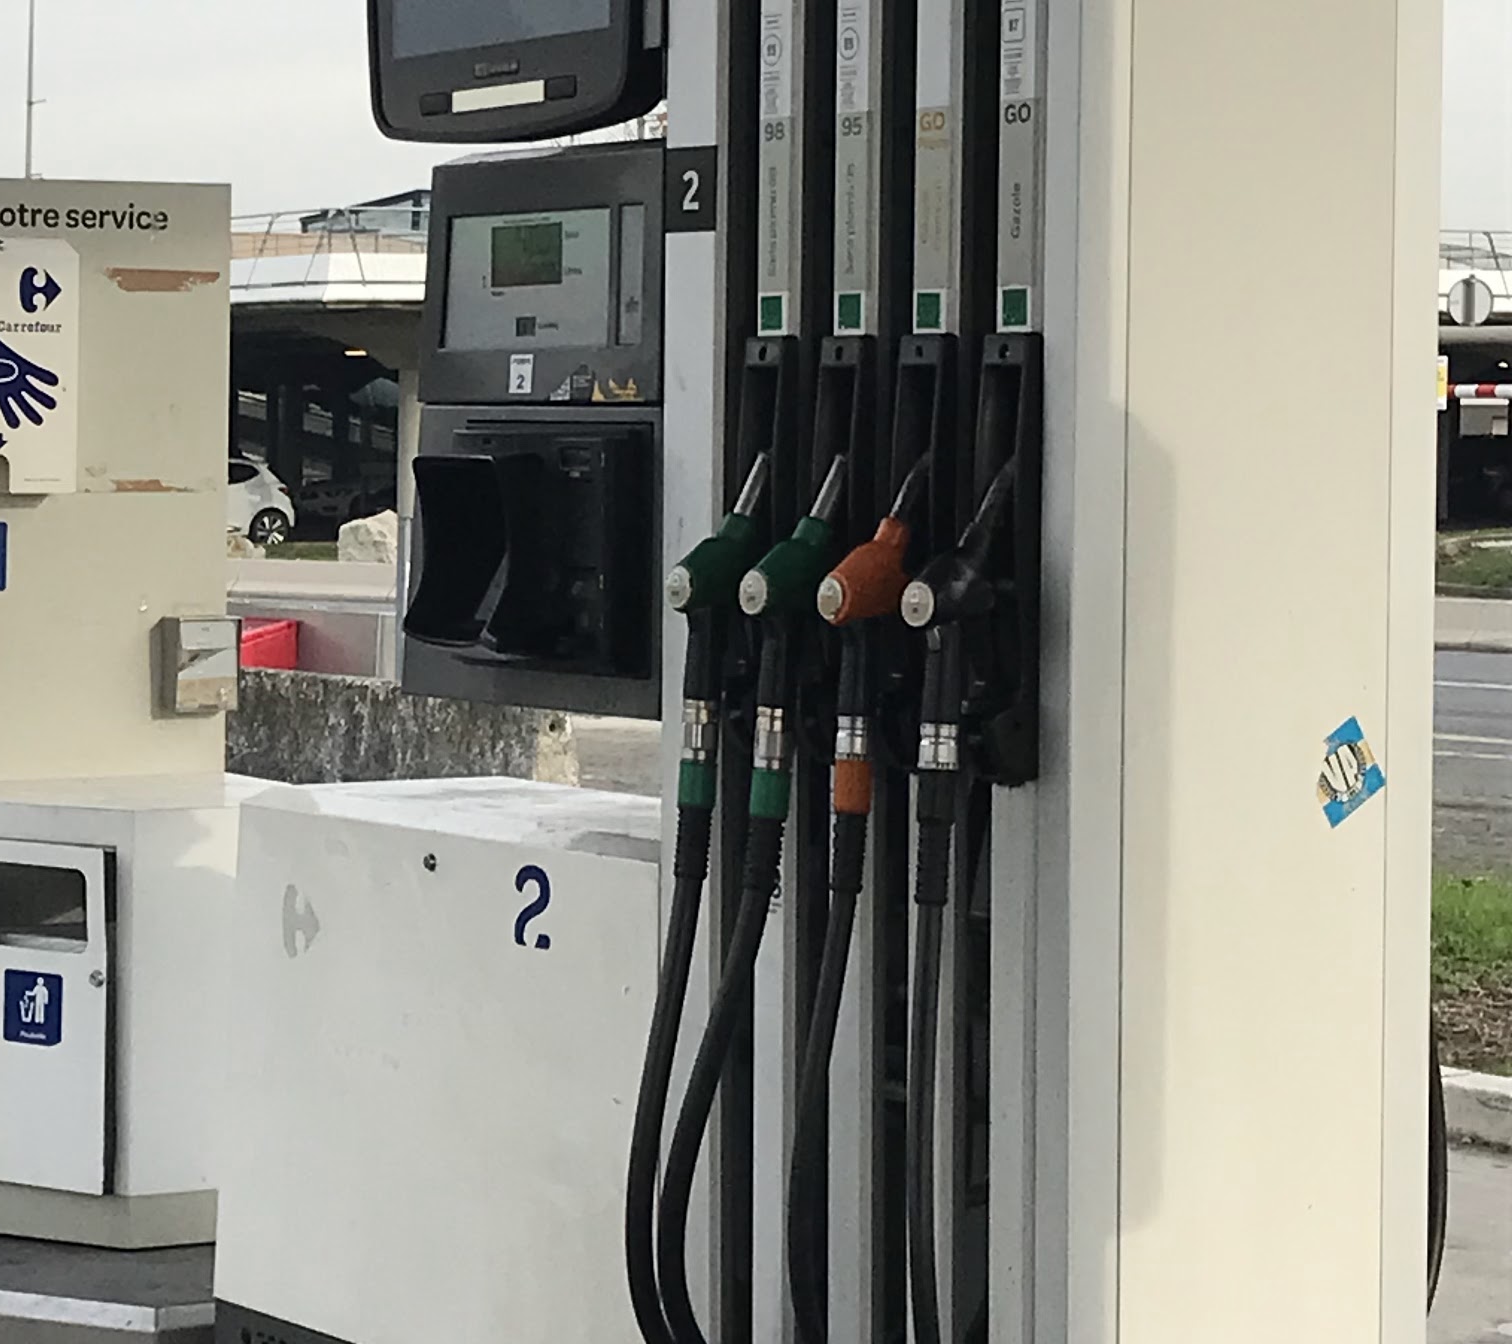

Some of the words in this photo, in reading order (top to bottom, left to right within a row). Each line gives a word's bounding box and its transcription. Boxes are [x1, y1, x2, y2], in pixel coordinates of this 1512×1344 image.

[919, 112, 945, 131] GO
[1004, 102, 1031, 124] GO
[764, 121, 785, 142] 98
[841, 116, 863, 136] 95
[682, 170, 699, 210] 2
[65, 203, 169, 230] service
[1010, 182, 1021, 239] Gazole
[516, 374, 526, 390] 2
[514, 864, 551, 950] 2
